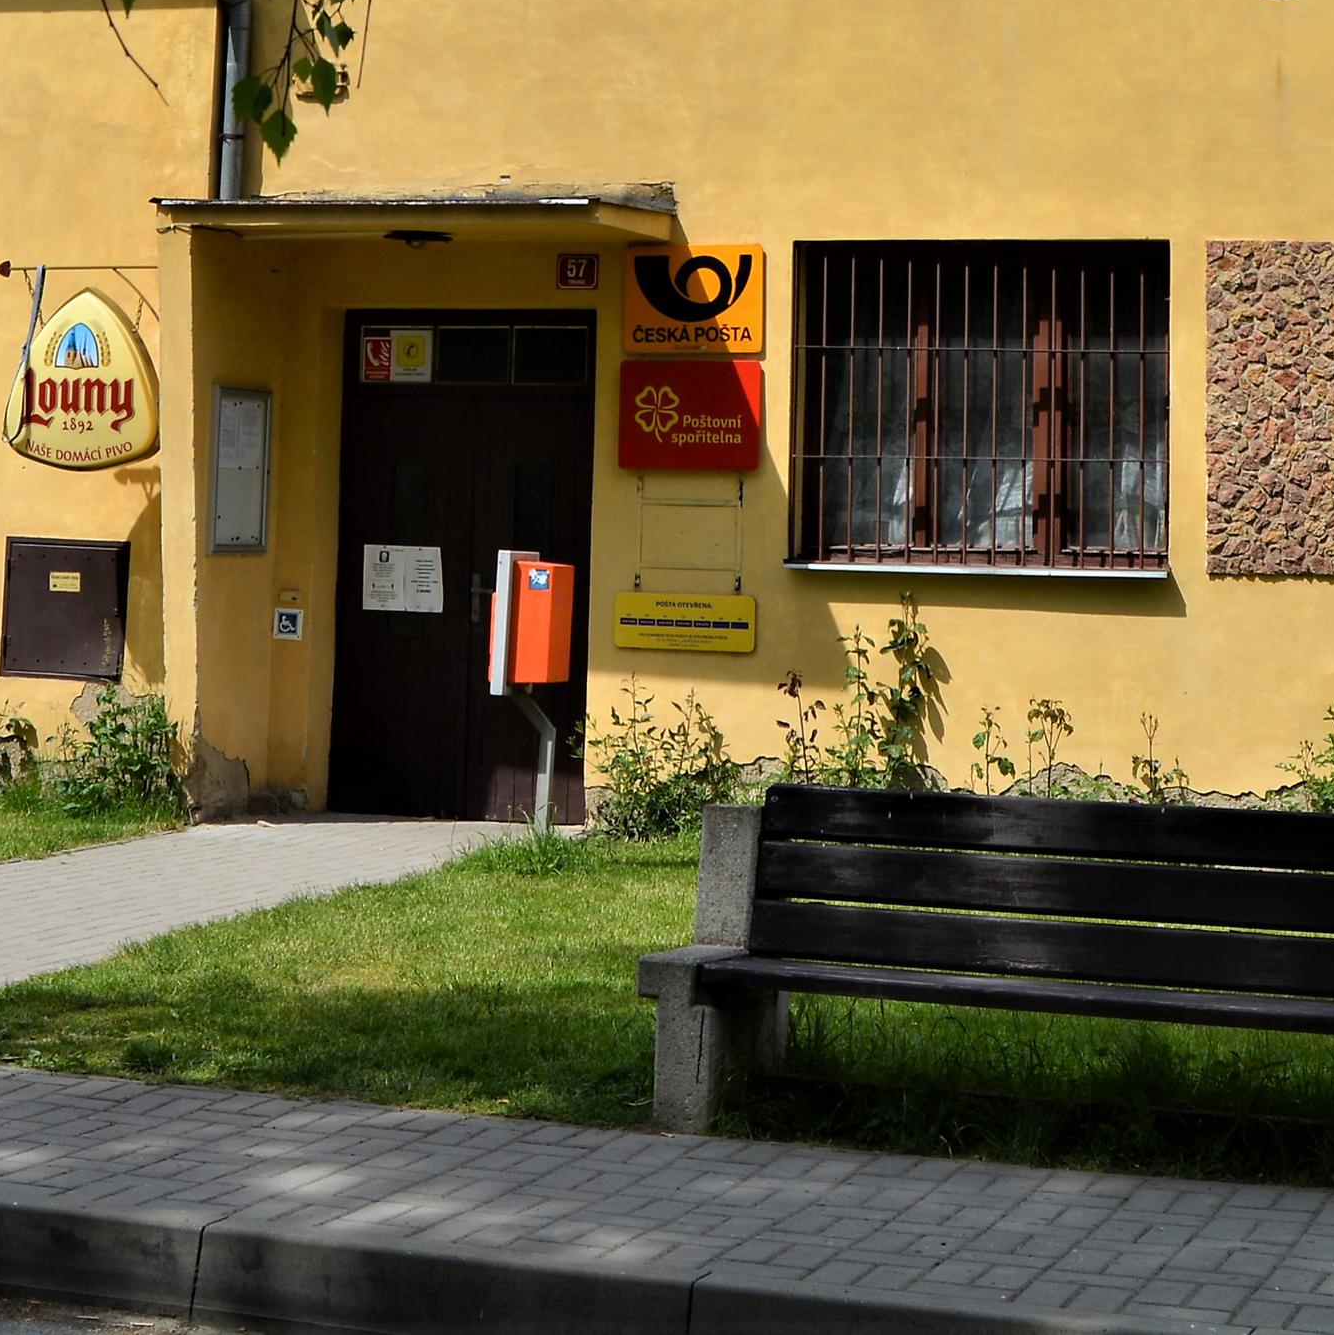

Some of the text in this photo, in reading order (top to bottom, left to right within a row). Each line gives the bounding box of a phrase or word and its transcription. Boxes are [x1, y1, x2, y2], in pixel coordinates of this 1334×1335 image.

[567, 259, 587, 277] 57
[632, 324, 752, 343] ČESKÁ POŠTA
[21, 367, 135, 433] Louny
[62, 417, 93, 434] 1892
[682, 414, 742, 428] Poštovní
[671, 430, 742, 447] spořitelna
[25, 438, 133, 462] NAŠE DOMÁCÍ PIVO
[656, 600, 676, 608] POŠTA
